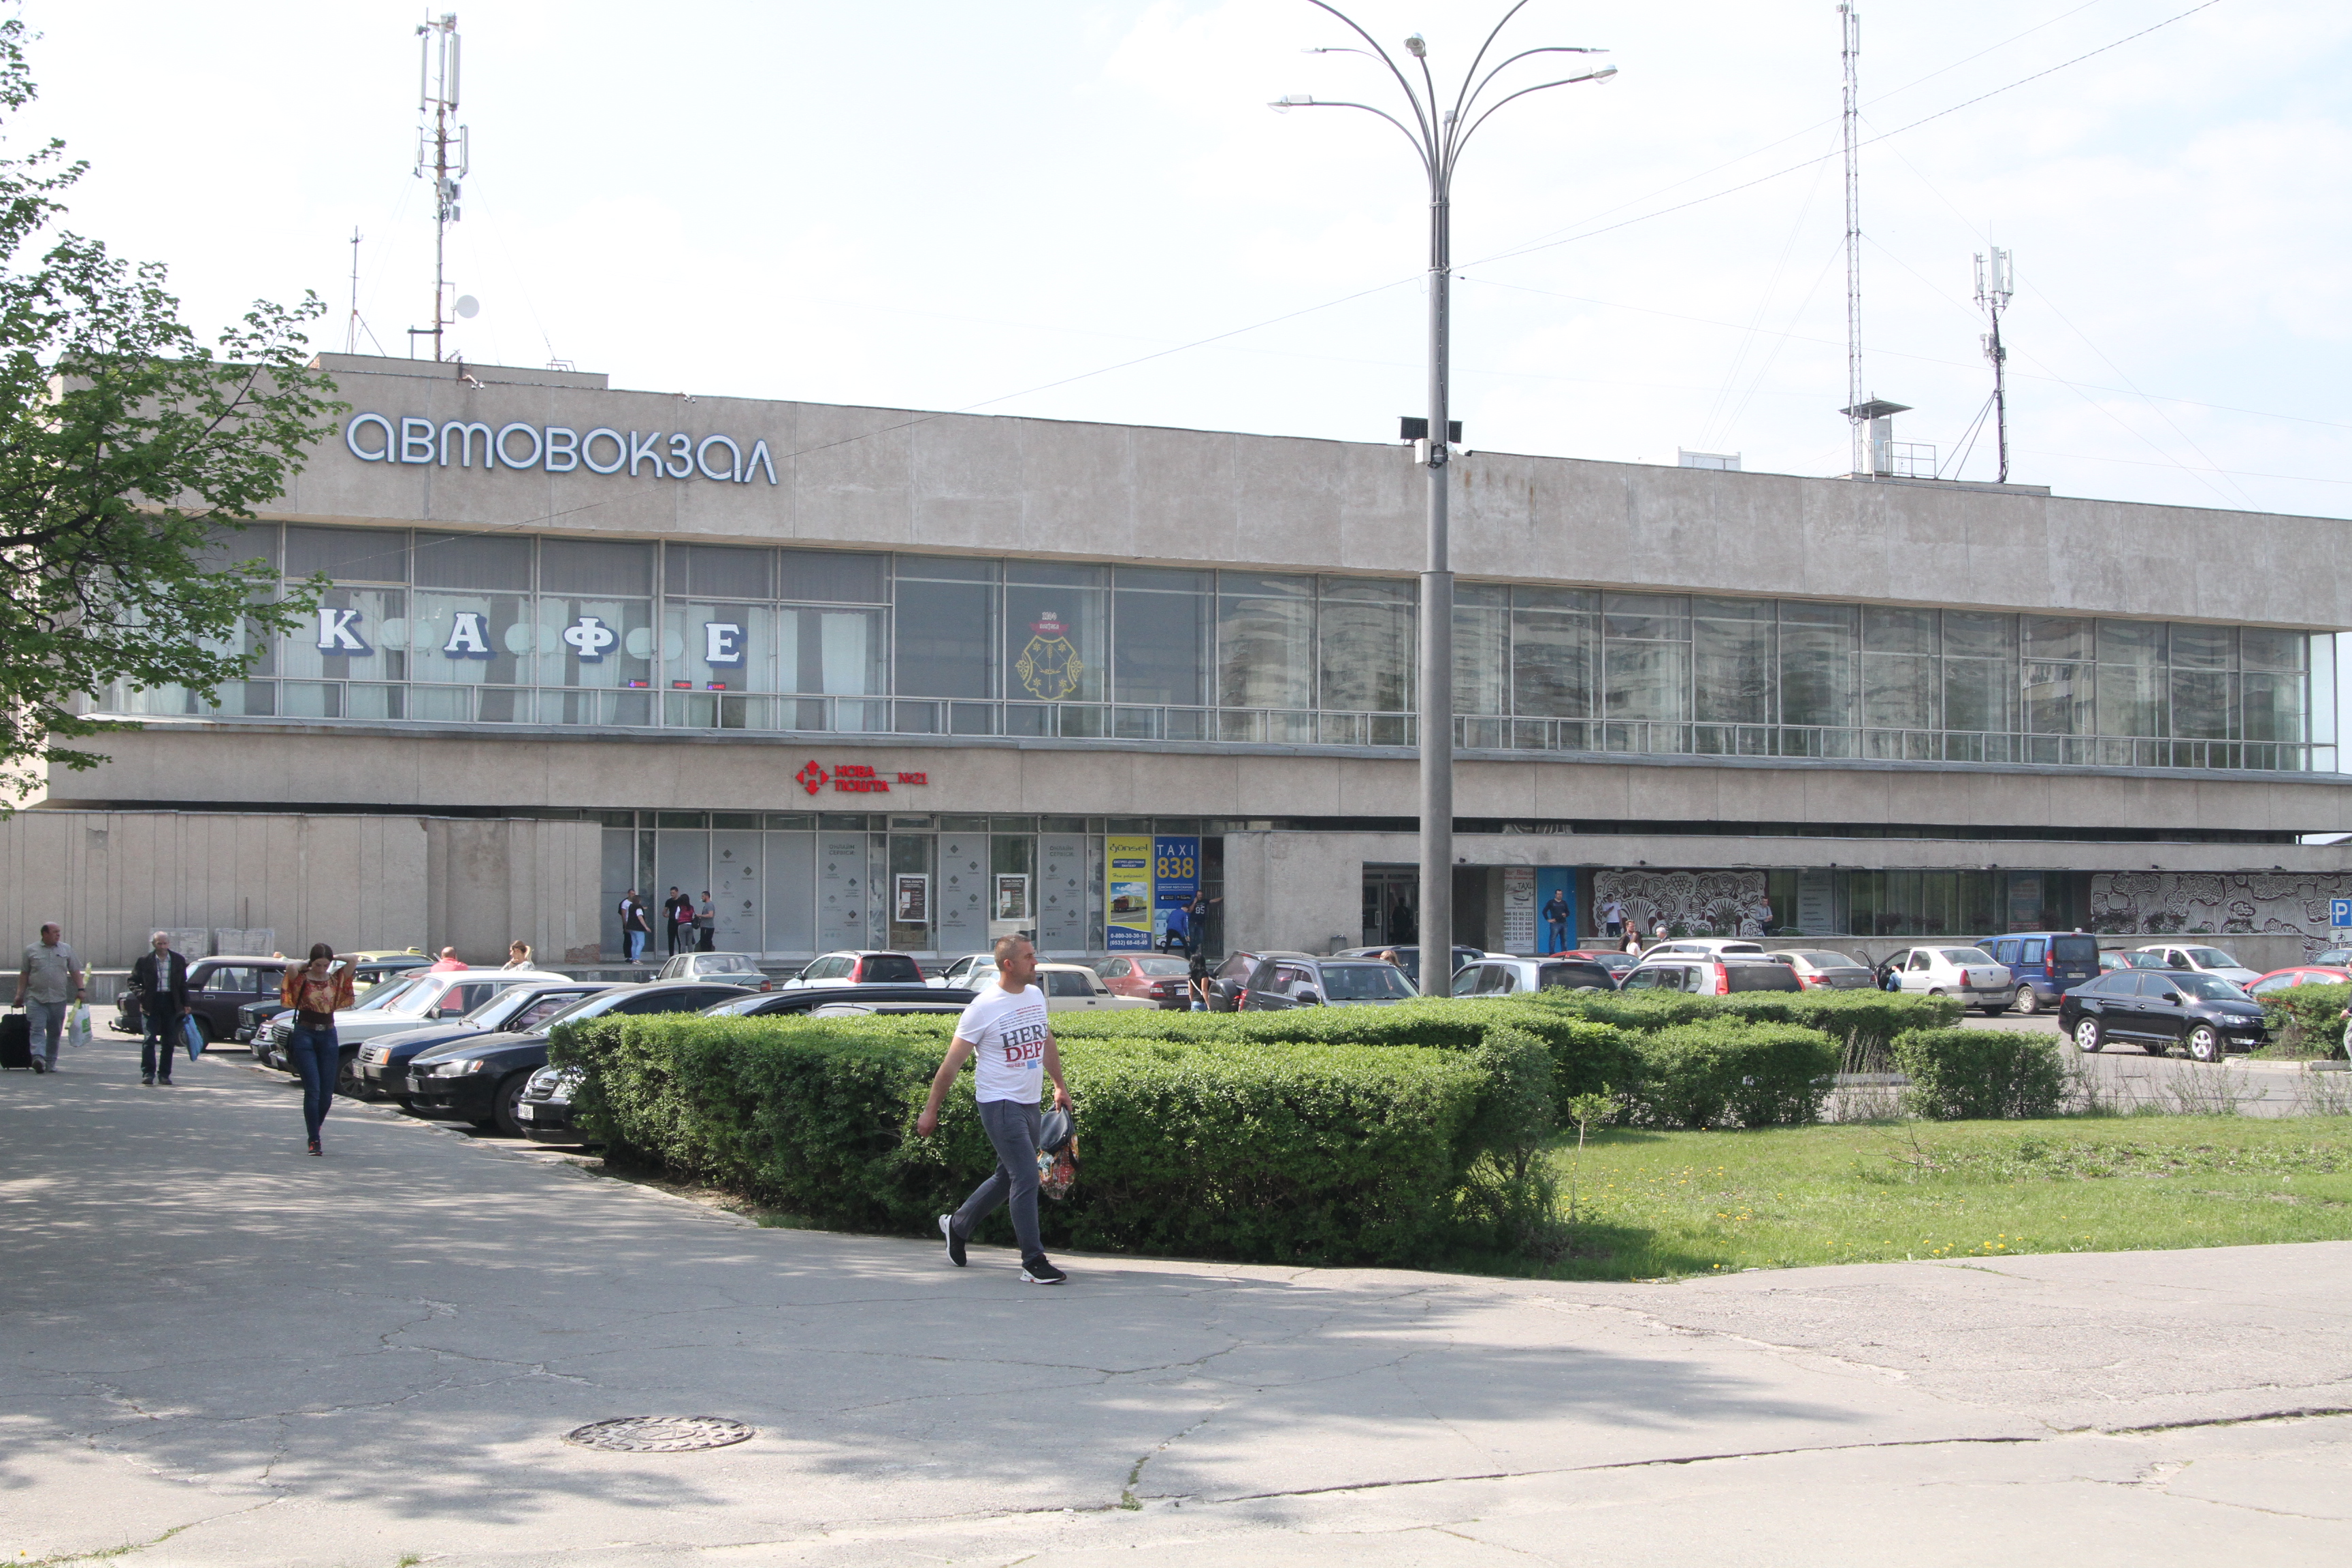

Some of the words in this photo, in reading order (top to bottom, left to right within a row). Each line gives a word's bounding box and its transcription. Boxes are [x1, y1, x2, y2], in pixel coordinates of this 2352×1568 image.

[834, 765, 876, 777] НОВА
[898, 772, 928, 785] №21
[834, 779, 889, 792] ПОШТА
[1157, 845, 1194, 856] TAXI
[1157, 857, 1194, 879] 838
[1195, 906, 1205, 914] 85
[2335, 902, 2348, 924] P
[1002, 1040, 1045, 1062] DEP
